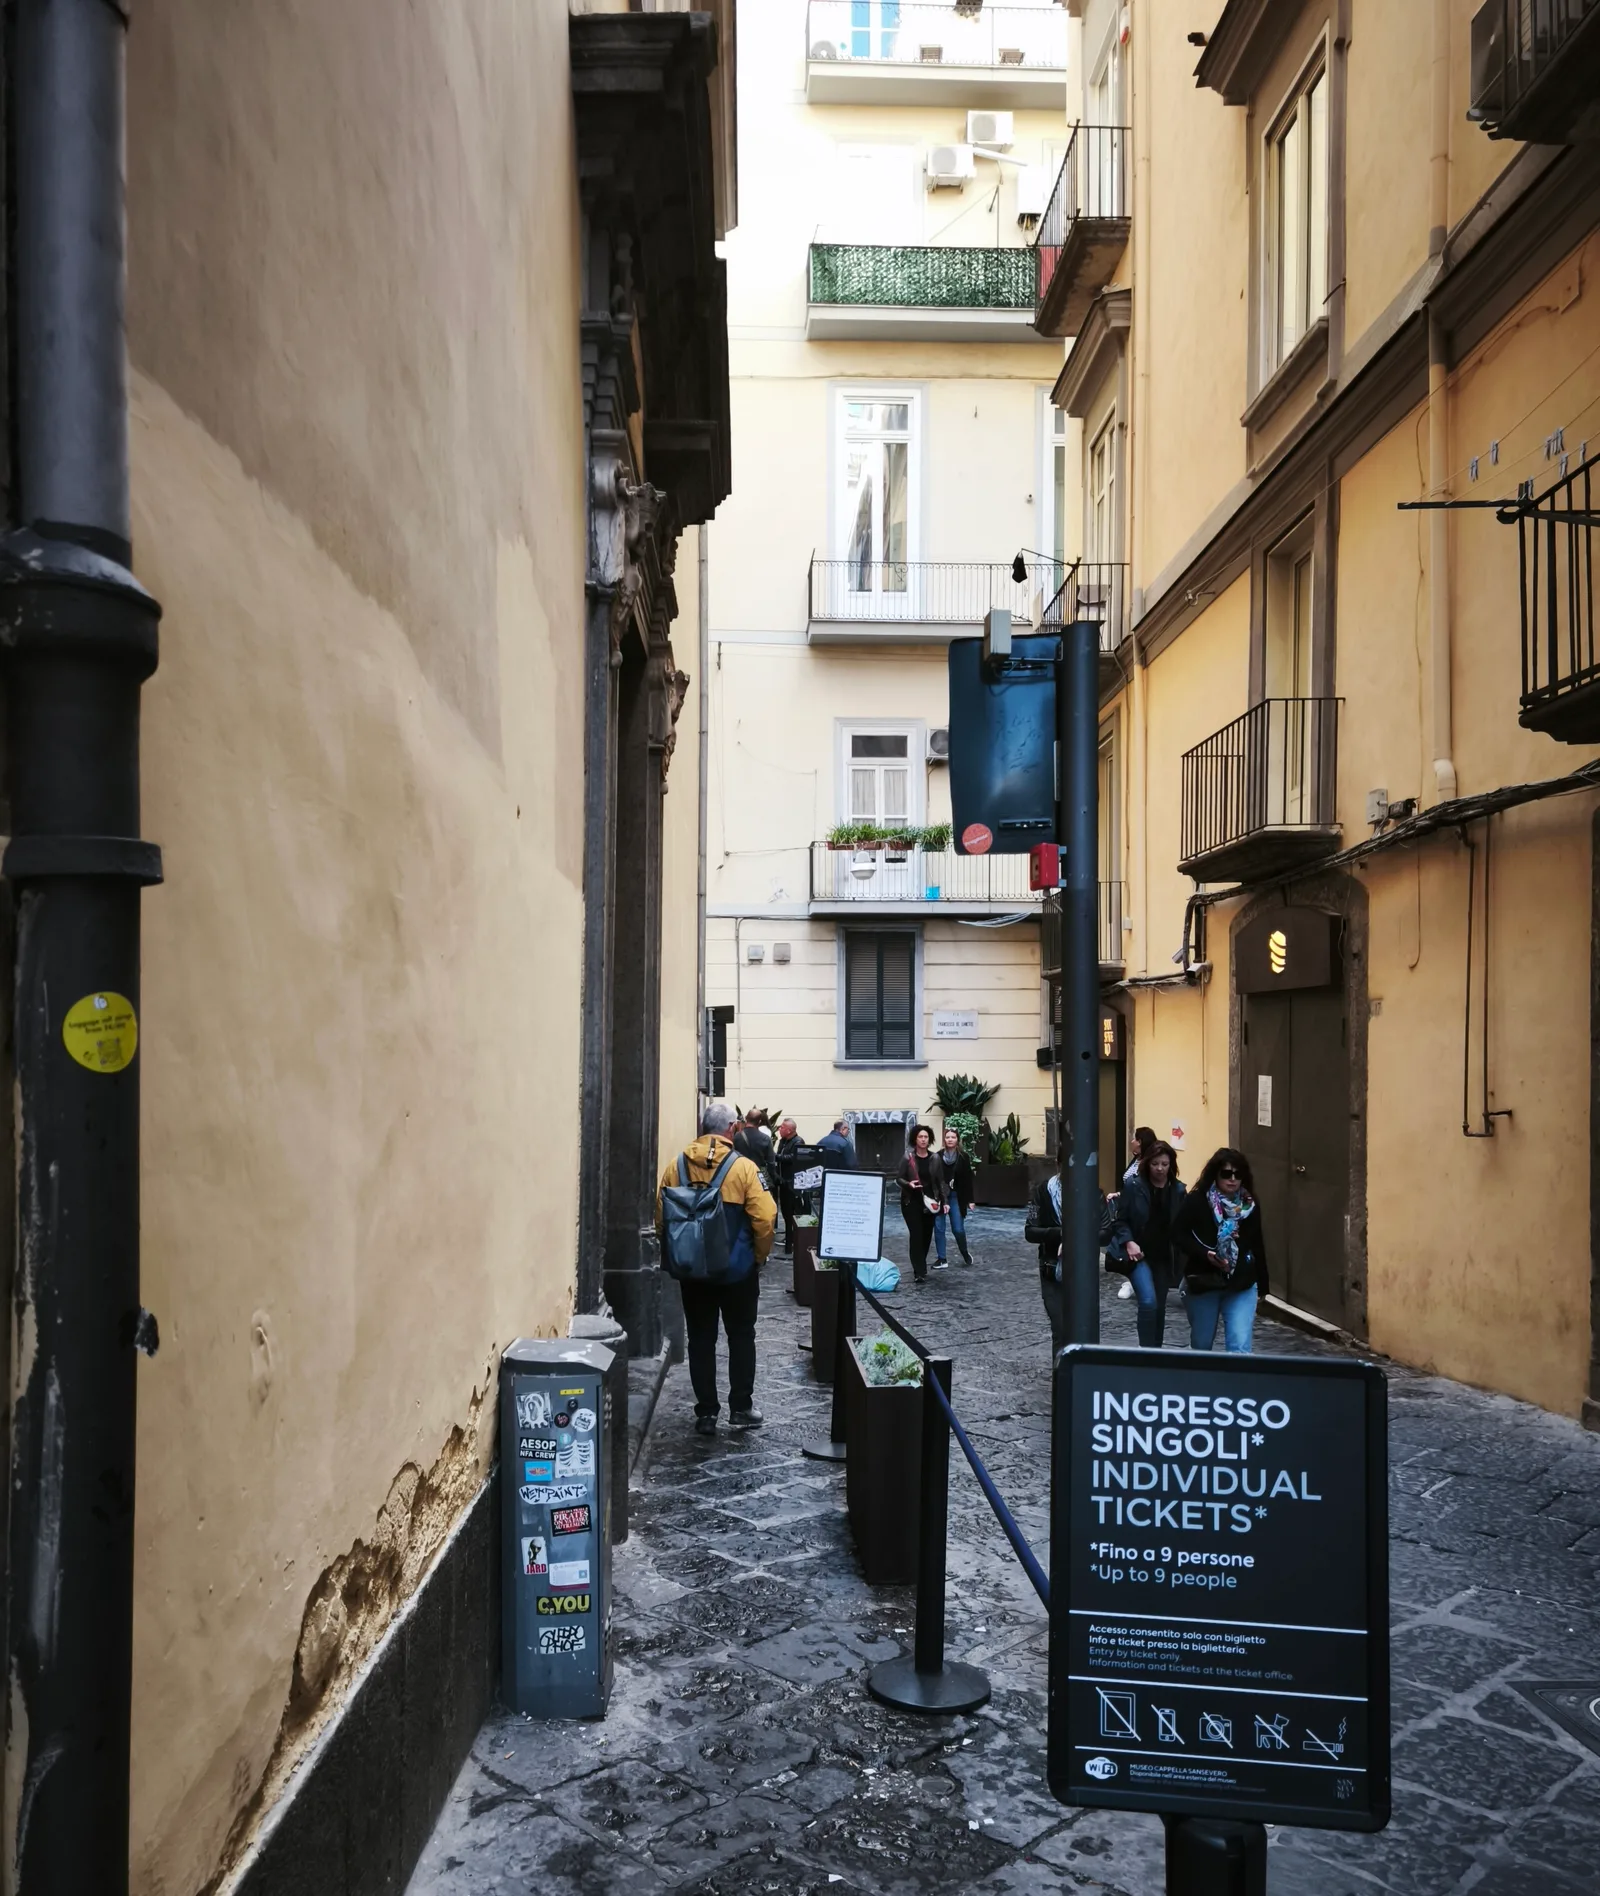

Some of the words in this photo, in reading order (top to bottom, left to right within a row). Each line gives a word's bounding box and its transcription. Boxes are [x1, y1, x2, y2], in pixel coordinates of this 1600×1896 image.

[1092, 1391, 1291, 1429] INGRESSO
[520, 1438, 556, 1450] AESOP
[520, 1450, 534, 1458] NFA
[534, 1451, 556, 1459] CREW
[1092, 1460, 1322, 1500] INDIVIDUAL
[553, 1511, 589, 1521] PIRATES
[1143, 1549, 1155, 1561] a
[1160, 1547, 1172, 1562] 9
[1177, 1551, 1255, 1568] persone
[1129, 1568, 1148, 1582] to
[1154, 1568, 1165, 1583] 9
[1171, 1571, 1237, 1589] people
[1089, 1624, 1127, 1634] Accesso
[1129, 1628, 1180, 1638] consentito
[1225, 1634, 1265, 1644] biglietto
[1089, 1636, 1107, 1644] Info
[1118, 1638, 1145, 1647] ticket
[1148, 1641, 1178, 1649] presso
[1192, 1643, 1247, 1654] biglietteria.
[1089, 1647, 1114, 1657] Entry
[1117, 1649, 1127, 1658] by
[1131, 1651, 1157, 1659] ticket
[1089, 1658, 1145, 1669] Information
[1169, 1664, 1200, 1673] tickets
[1203, 1666, 1213, 1674] at
[1216, 1667, 1232, 1675] the
[1235, 1669, 1261, 1677] ticket
[1154, 1765, 1187, 1773] CAPPELLA
[1188, 1768, 1227, 1776] SANSEVERO
